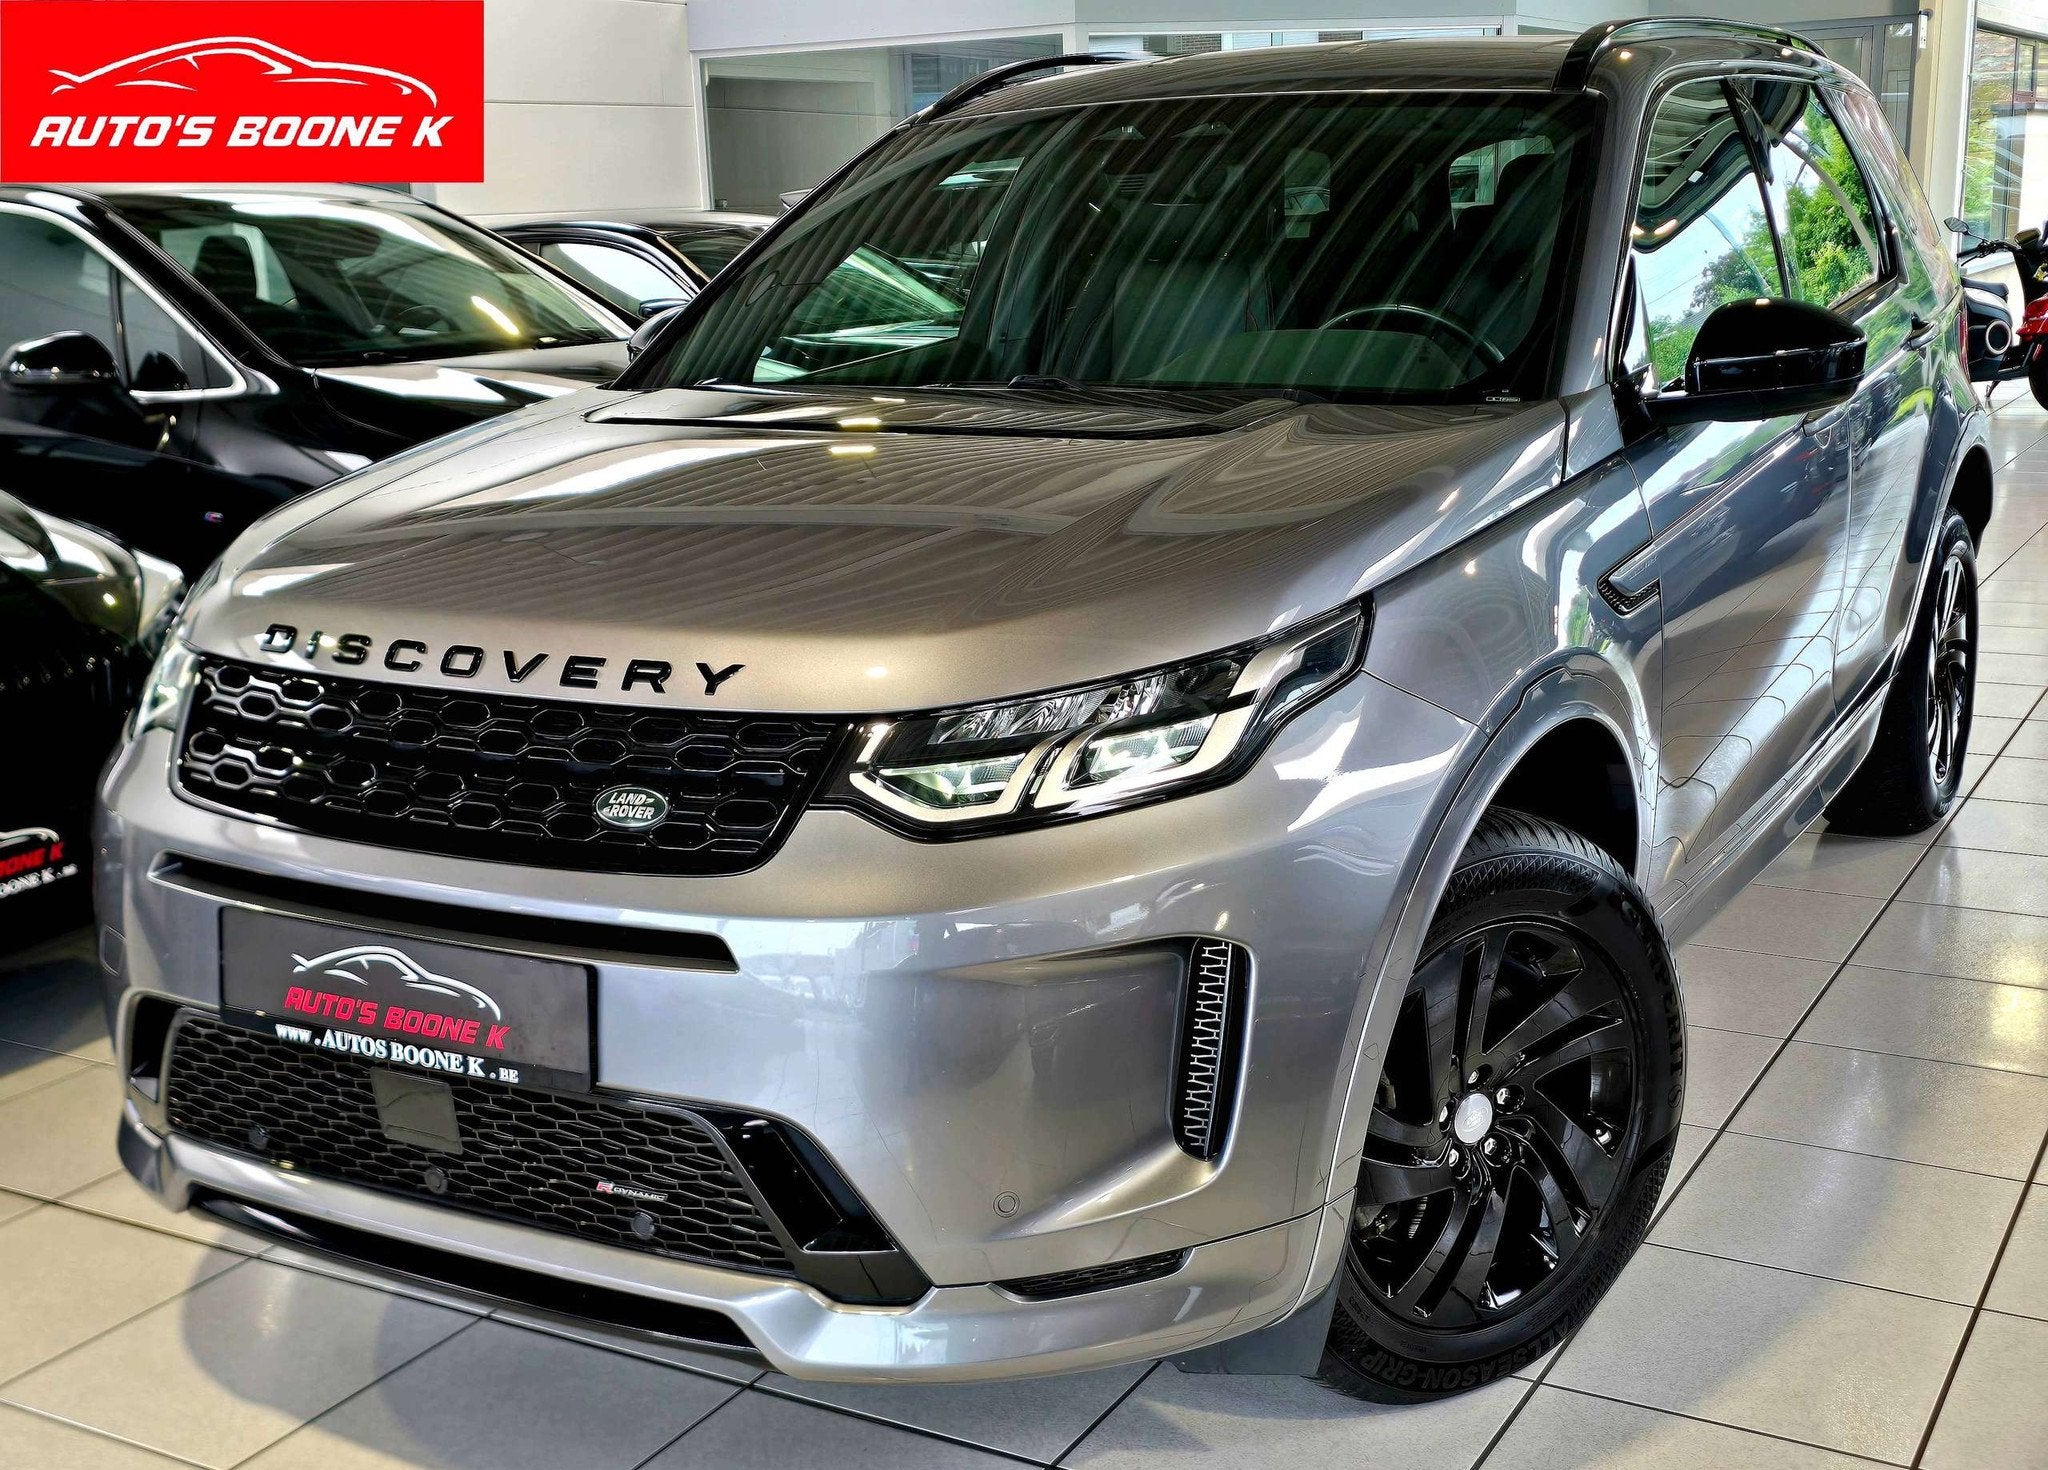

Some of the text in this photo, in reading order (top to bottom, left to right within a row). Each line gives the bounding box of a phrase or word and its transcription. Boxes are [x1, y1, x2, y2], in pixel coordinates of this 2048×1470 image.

[257, 623, 747, 697] DISCOVERY
[609, 792, 647, 805] LAND
[609, 804, 655, 820] ROVER
[284, 986, 510, 1050] AUTO'S BOONE K
